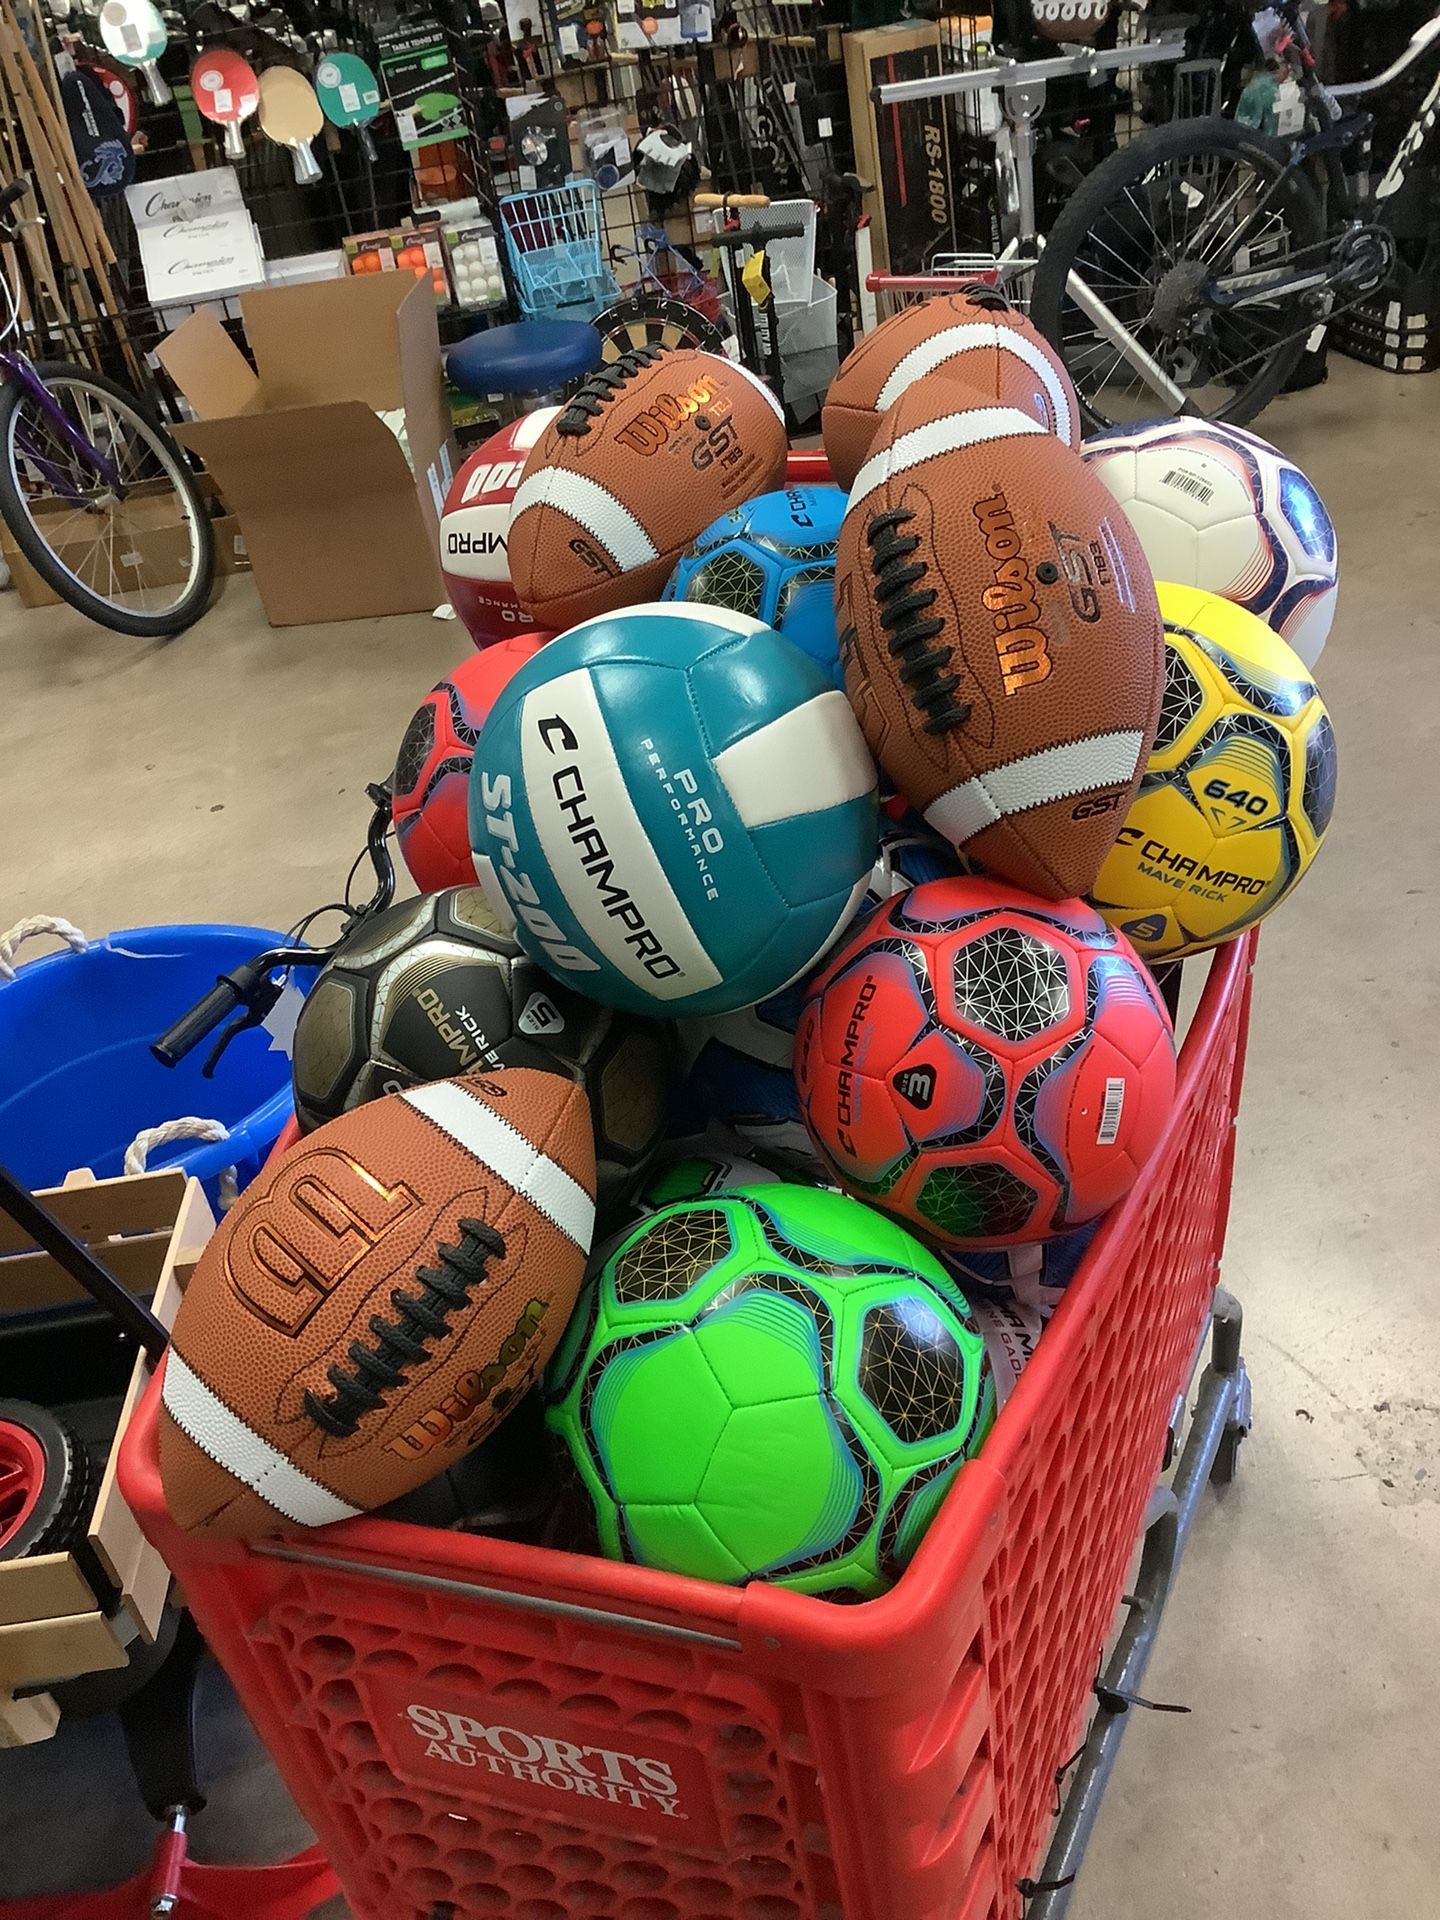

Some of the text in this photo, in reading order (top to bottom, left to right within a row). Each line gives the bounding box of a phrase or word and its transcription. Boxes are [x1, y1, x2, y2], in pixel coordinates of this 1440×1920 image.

[923, 124, 948, 224] RS-1800
[614, 373, 719, 457] Wilson
[691, 414, 739, 472] GST
[569, 538, 616, 577] GST
[972, 490, 1054, 697] Wilson
[1047, 520, 1101, 624] GST
[1088, 539, 1111, 586] 1783
[640, 738, 719, 901] PERFORMANCE
[673, 768, 725, 854] PRO
[1071, 791, 1126, 821] GST
[1203, 778, 1268, 817] 640
[480, 771, 601, 972] ST-200
[552, 765, 681, 980] CHAMPRO
[1140, 839, 1267, 897] CHAMPRO
[1133, 921, 1159, 939] 5
[530, 1001, 558, 1028] 5
[837, 983, 878, 1127] CHAMPRO
[907, 1072, 931, 1102] 3
[382, 1296, 551, 1462] Wilson
[406, 1704, 678, 1797] SPORTS
[423, 1739, 682, 1819] AUTHORITY
